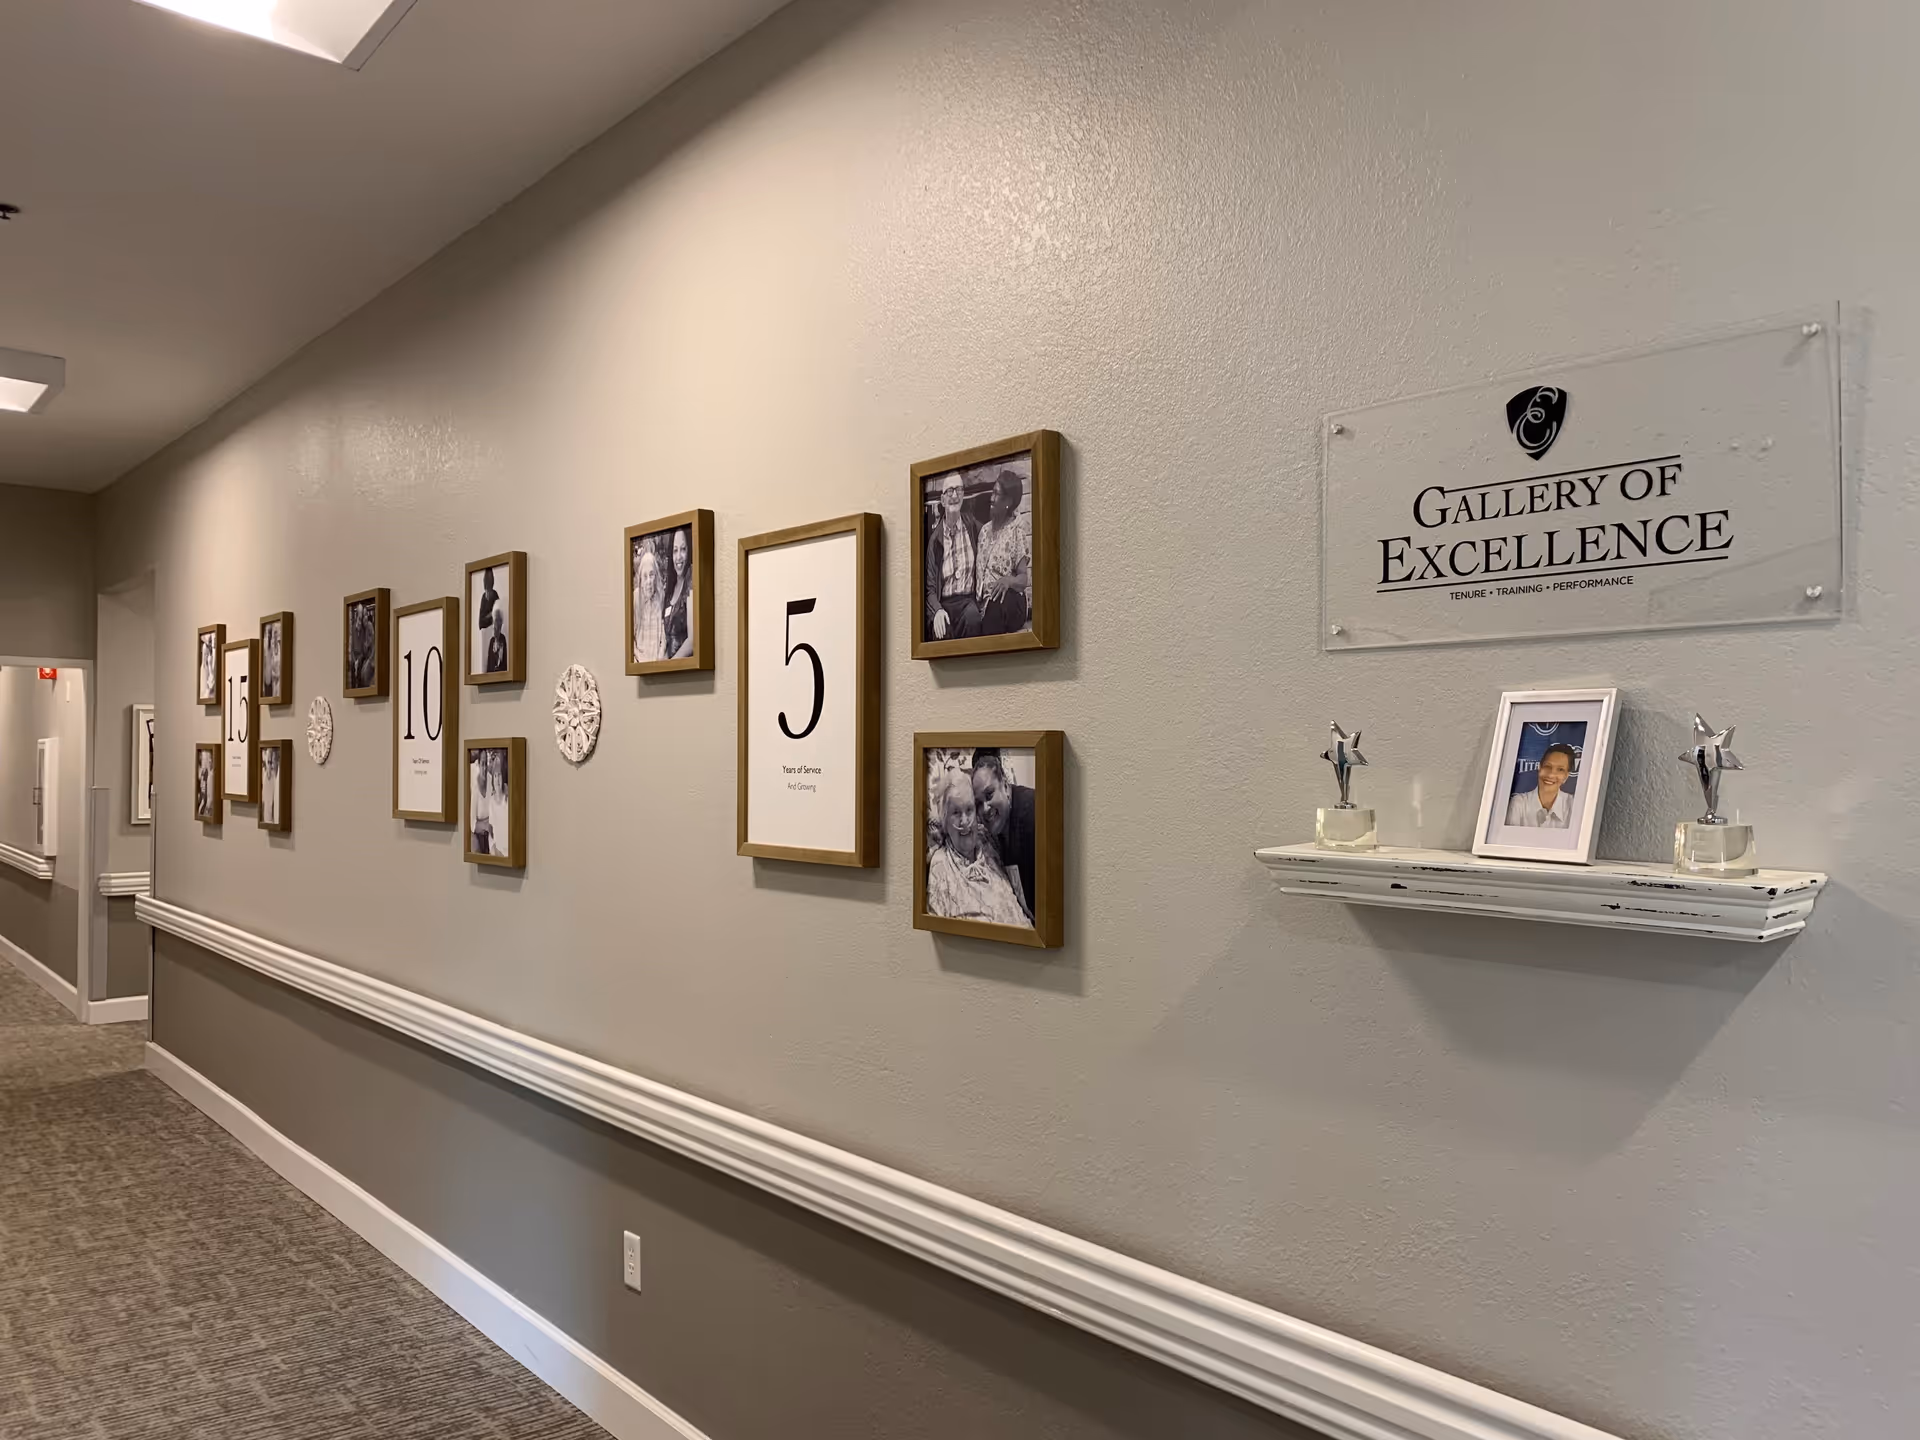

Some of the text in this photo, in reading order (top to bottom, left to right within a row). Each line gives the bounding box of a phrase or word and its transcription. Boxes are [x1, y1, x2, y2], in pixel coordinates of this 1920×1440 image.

[1619, 463, 1682, 501] OF
[1378, 509, 1735, 585] EXCELLENCE
[1449, 576, 1634, 600] TENURE TRAINING PERFORMANCE
[403, 646, 443, 741] 10
[778, 597, 825, 740] 5
[227, 675, 248, 743] 15
[782, 765, 796, 774] Years
[803, 765, 822, 774] Service
